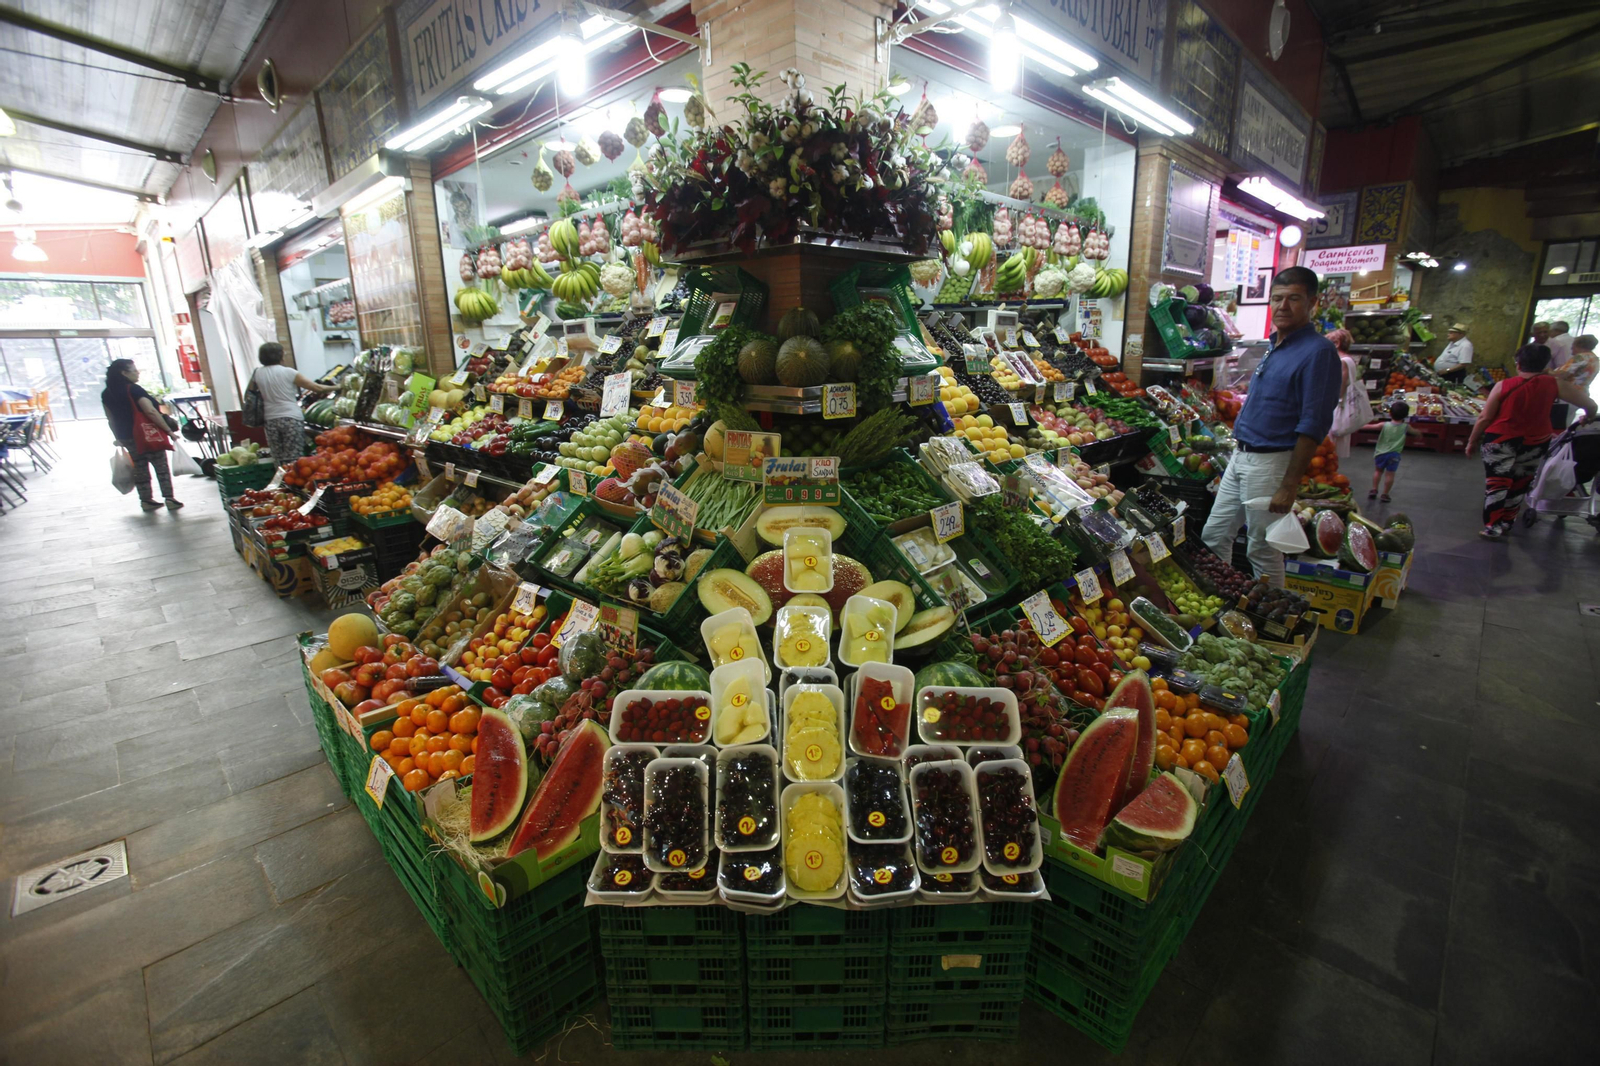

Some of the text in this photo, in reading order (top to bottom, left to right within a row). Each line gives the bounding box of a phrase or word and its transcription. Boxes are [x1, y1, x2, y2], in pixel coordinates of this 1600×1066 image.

[1145, 26, 1155, 50] 17
[413, 0, 478, 96] FRUTAS
[1345, 256, 1379, 265] Romero
[727, 432, 752, 446] FRUTAS
[765, 458, 807, 475] Frutas
